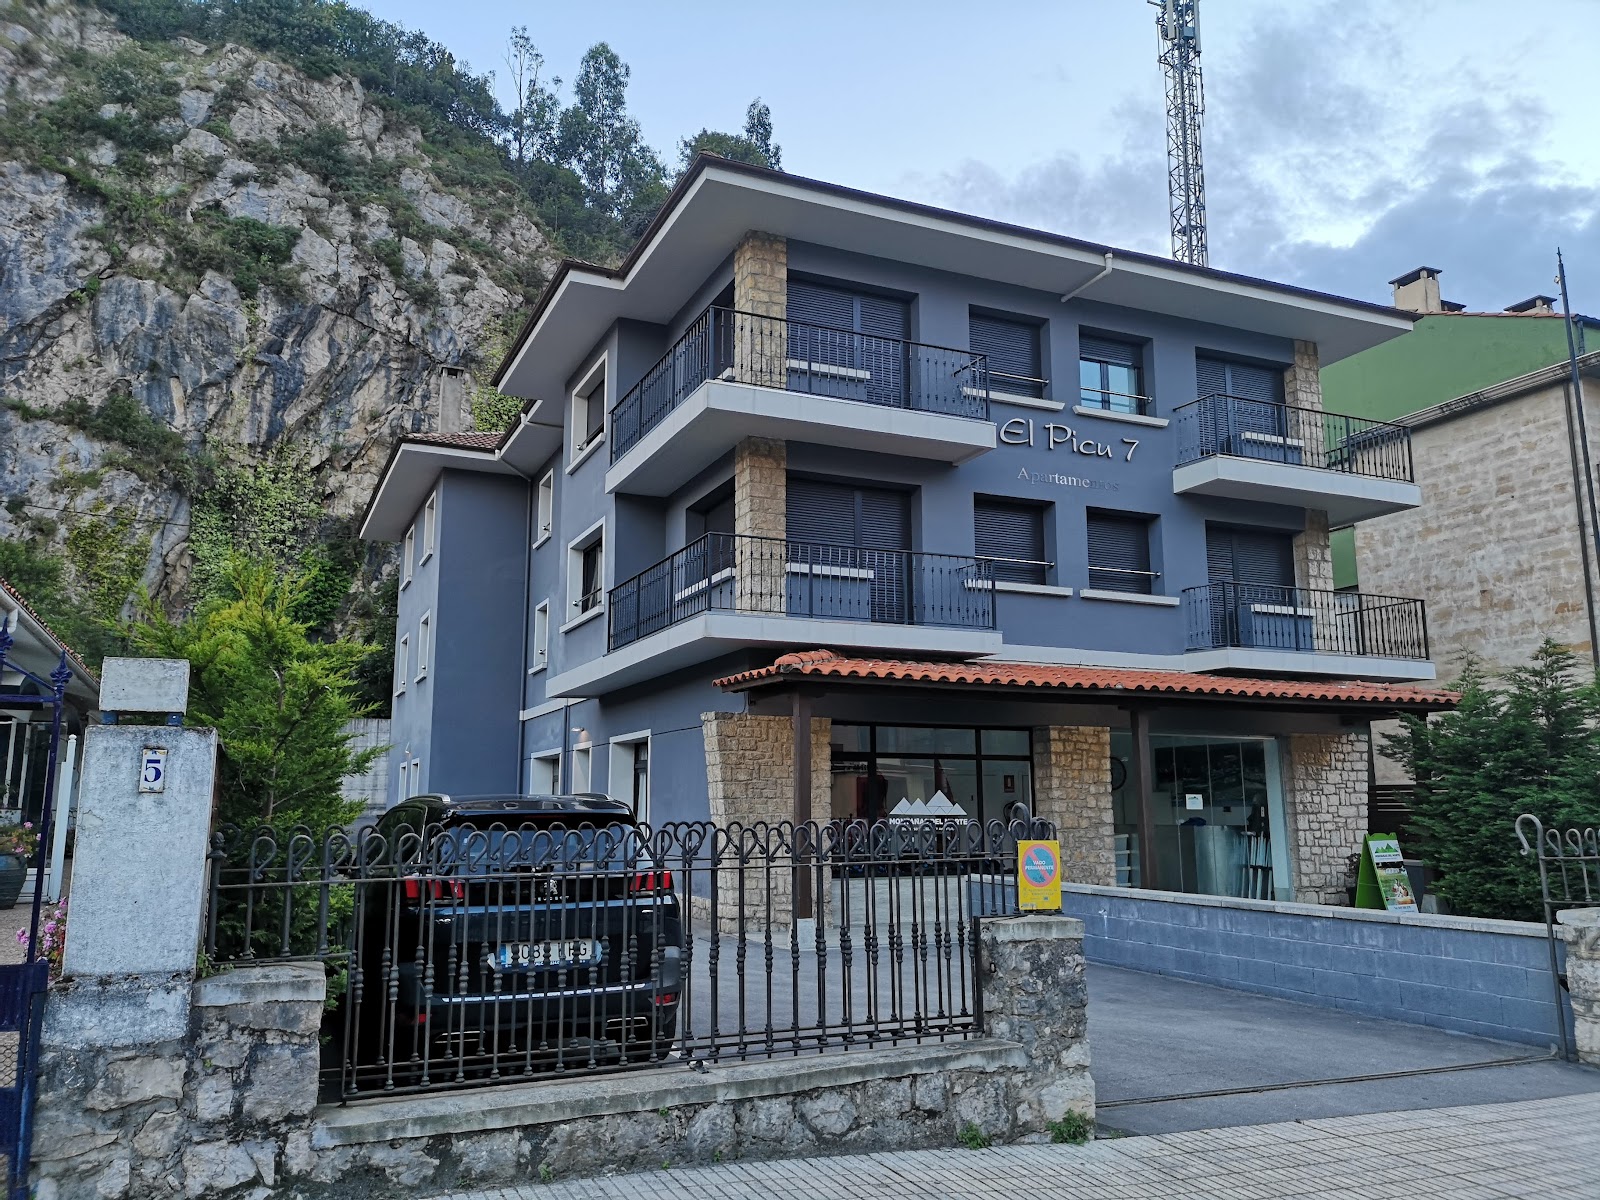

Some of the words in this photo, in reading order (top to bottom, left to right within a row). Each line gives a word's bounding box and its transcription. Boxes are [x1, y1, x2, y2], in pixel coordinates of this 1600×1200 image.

[999, 418, 1034, 447] El
[1044, 422, 1113, 458] Picu
[1121, 437, 1140, 462] 7
[1017, 467, 1120, 491] Apartamentos
[144, 759, 162, 782] 5
